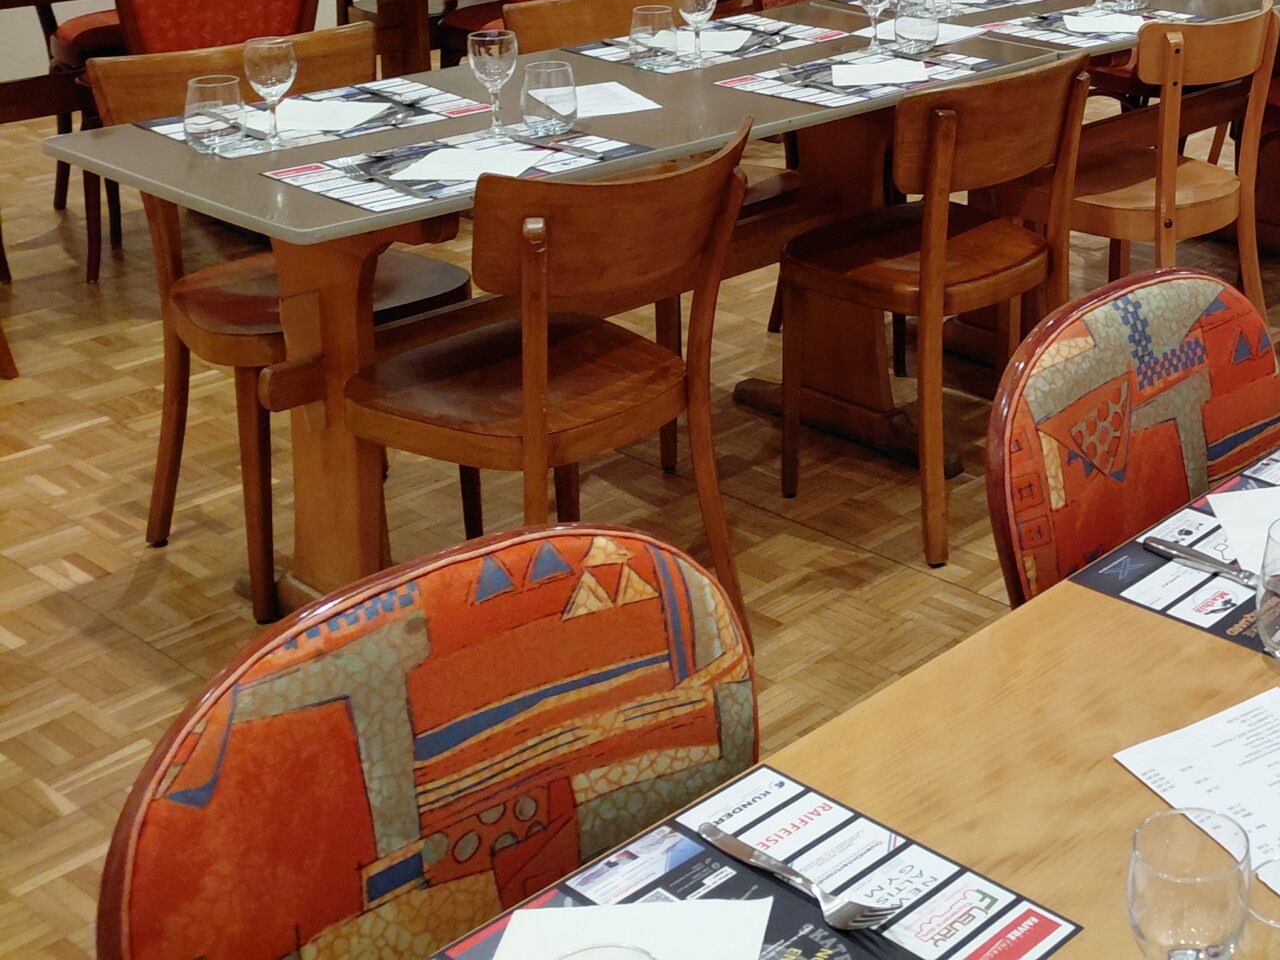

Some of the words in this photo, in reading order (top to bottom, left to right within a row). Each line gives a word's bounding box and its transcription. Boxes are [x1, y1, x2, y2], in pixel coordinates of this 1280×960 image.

[709, 789, 774, 826] KUNDER
[751, 801, 836, 852] RAIFFEISE
[865, 864, 914, 899] GYM
[877, 869, 924, 904] ALTIS
[931, 888, 999, 948] FLEURY
[1005, 916, 1040, 941] FAIVRE
